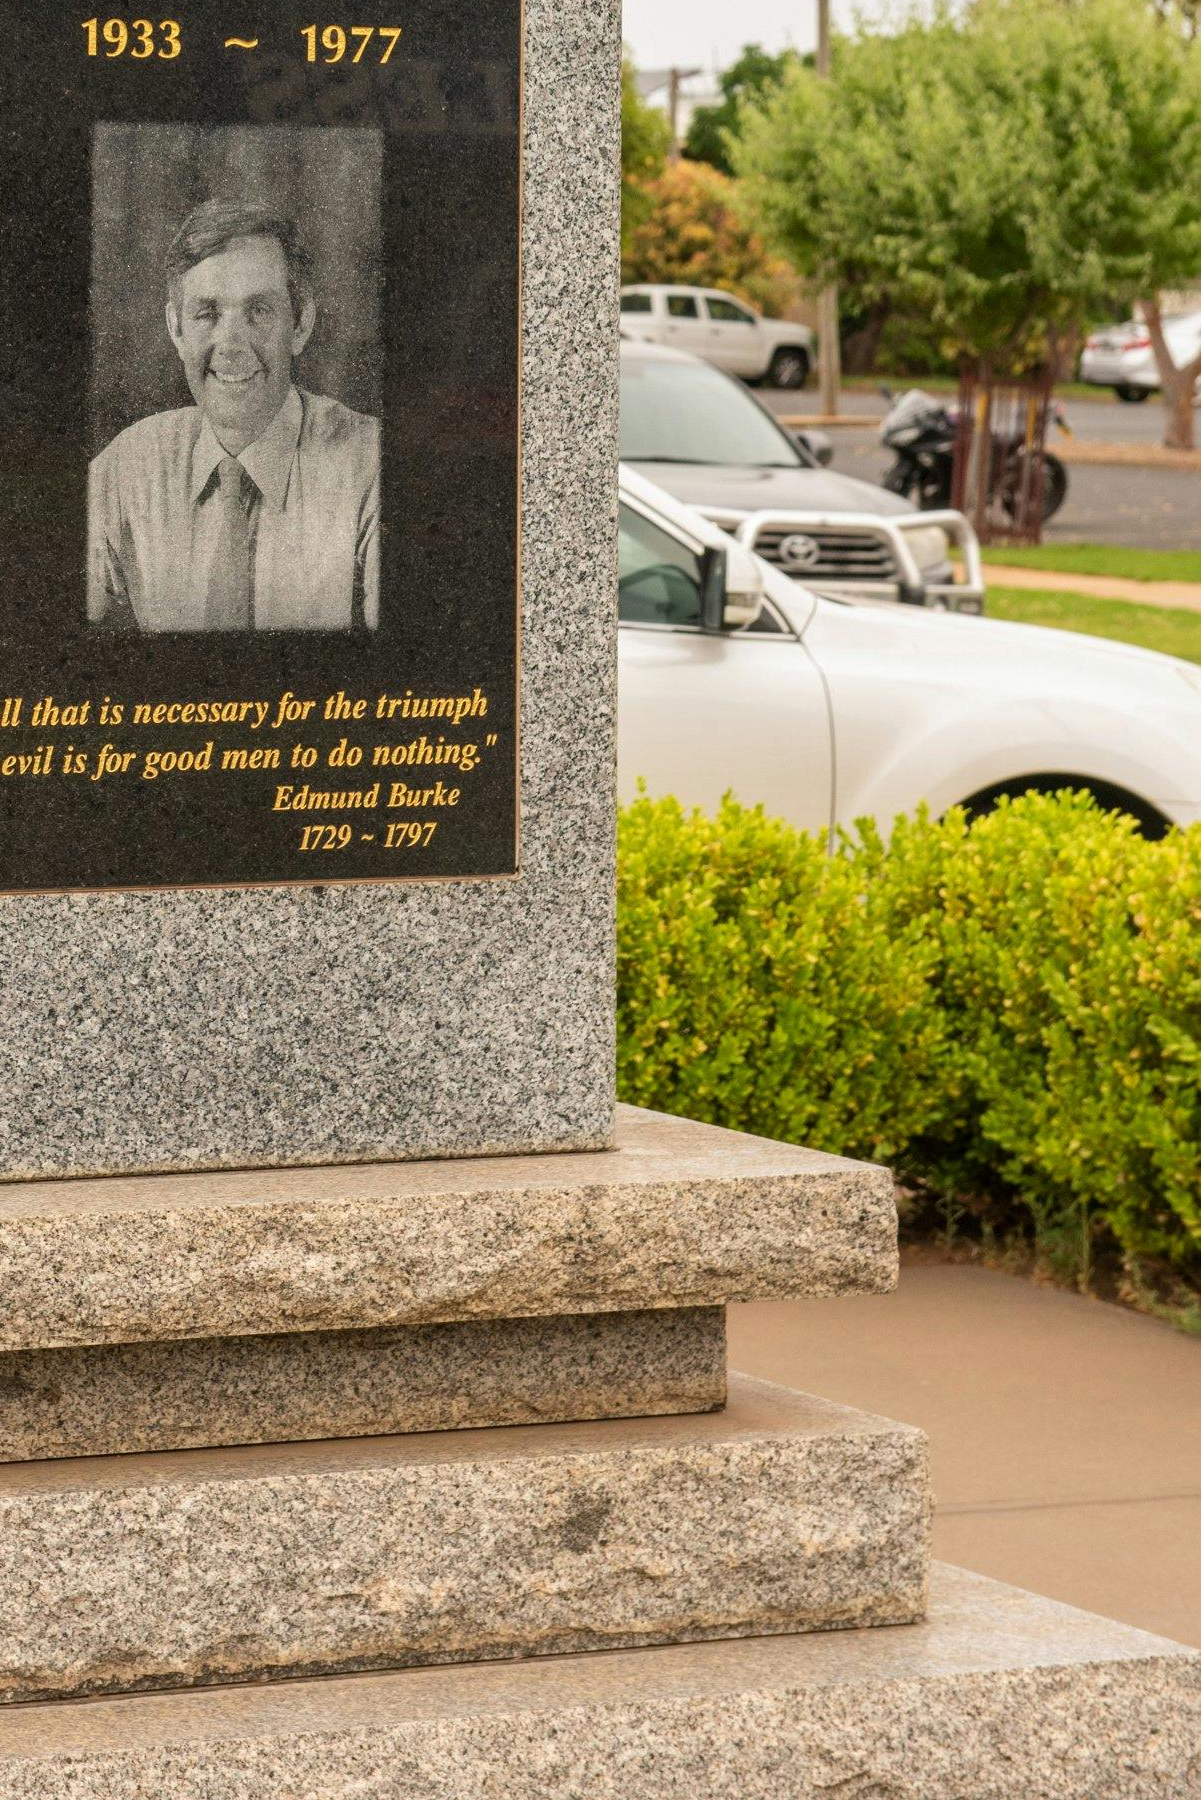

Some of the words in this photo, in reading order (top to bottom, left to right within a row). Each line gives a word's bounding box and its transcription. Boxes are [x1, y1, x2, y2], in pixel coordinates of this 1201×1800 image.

[82, 18, 182, 59] 1933
[301, 24, 402, 64] 1977
[31, 696, 91, 727] that
[99, 696, 123, 726] is
[133, 701, 270, 729] necessary
[271, 691, 316, 729] for
[323, 690, 368, 720] the
[375, 688, 488, 725] triumph
[1, 745, 54, 776] evil
[62, 745, 88, 775] is
[90, 743, 137, 781] for
[142, 740, 214, 780] good
[221, 748, 281, 770] men
[290, 743, 319, 768] to
[328, 738, 363, 767] do
[372, 733, 498, 772] nothing."
[272, 782, 380, 811] Edmund
[388, 781, 461, 808] Burke
[300, 824, 352, 851] 1729
[384, 822, 437, 848] 1797
